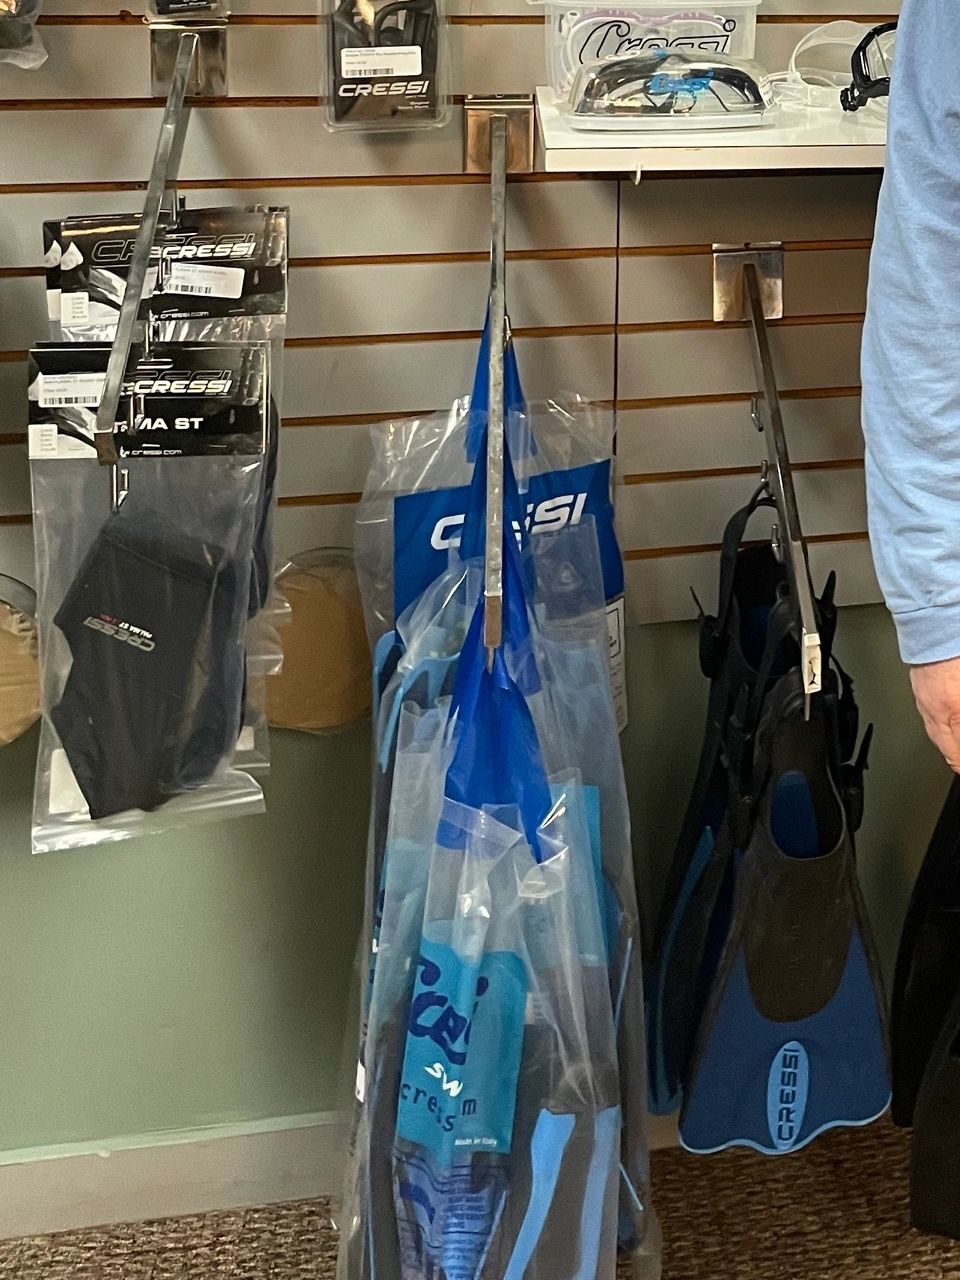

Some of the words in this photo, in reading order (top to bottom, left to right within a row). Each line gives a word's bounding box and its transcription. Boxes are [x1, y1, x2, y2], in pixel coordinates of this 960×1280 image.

[338, 80, 430, 97] CRESSI
[163, 242, 257, 259] CRESSI
[134, 379, 233, 394] CRESSI
[174, 417, 204, 430] ST
[83, 616, 156, 652] CRESSI
[777, 1048, 800, 1141] CRESSI
